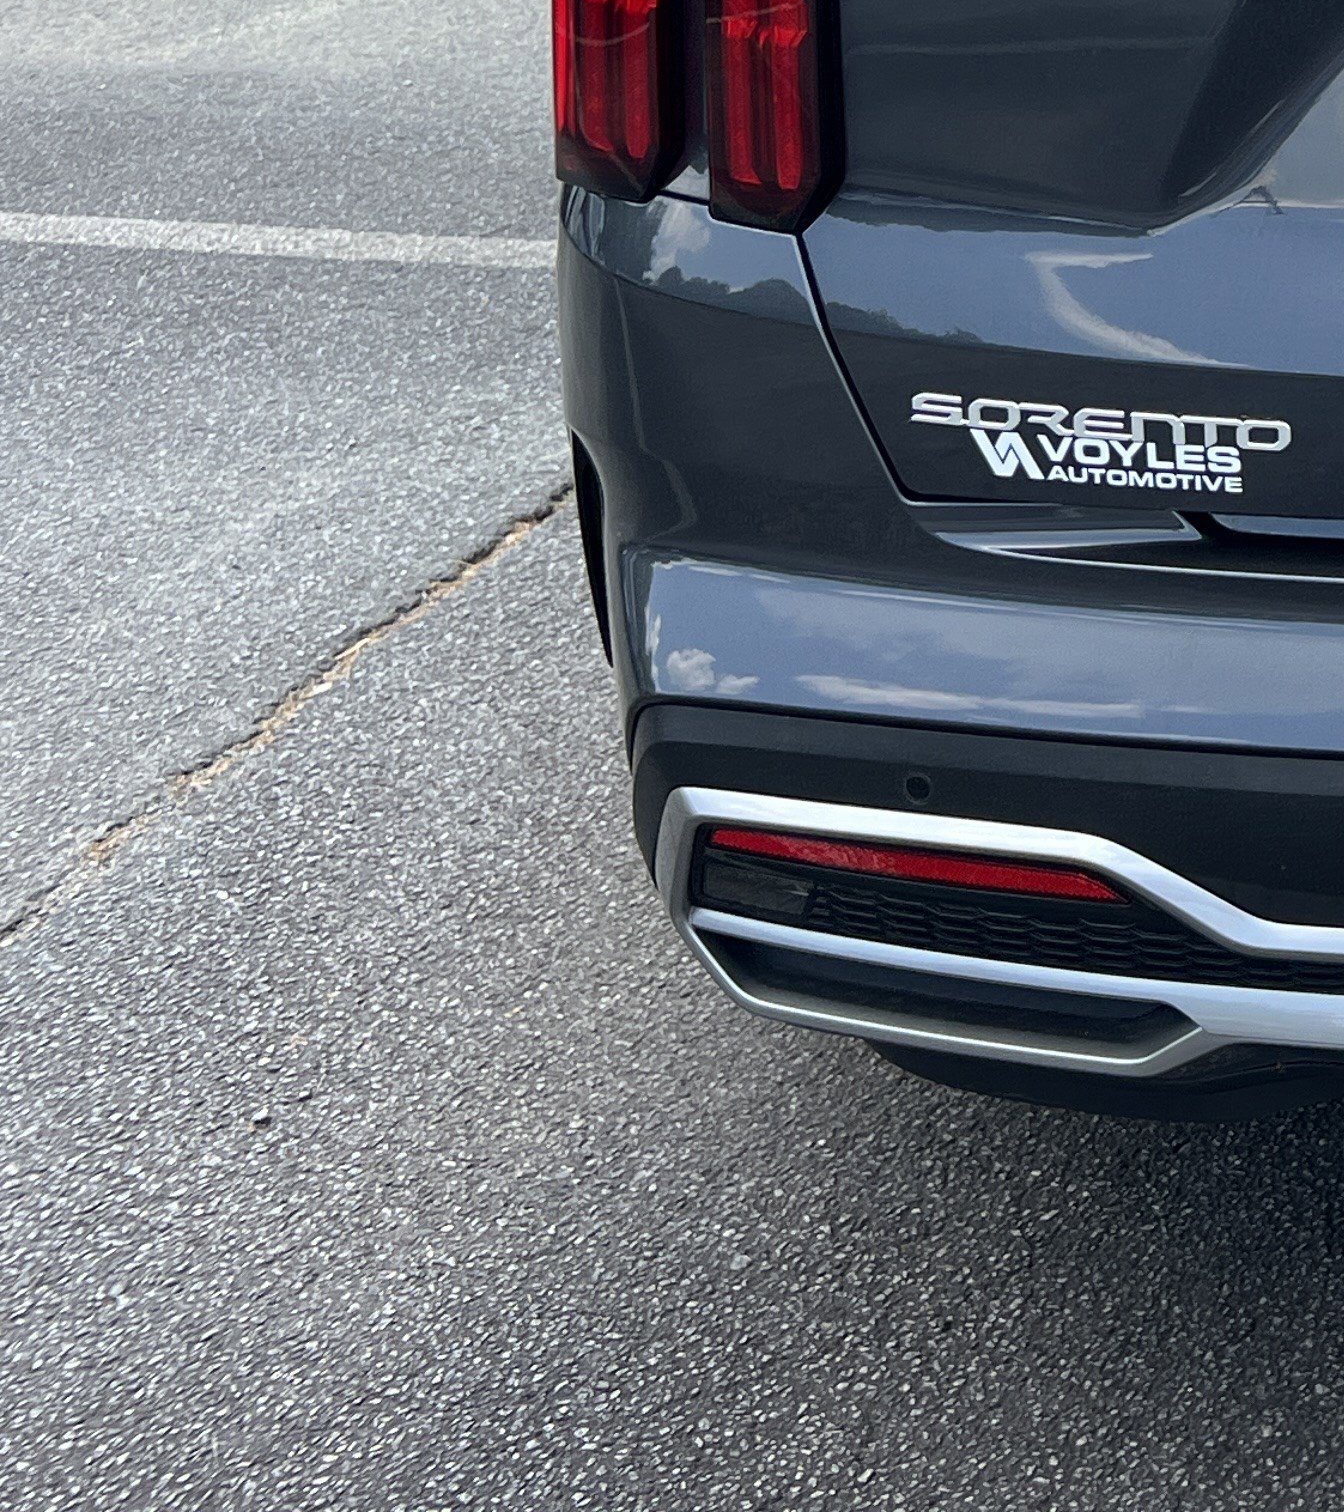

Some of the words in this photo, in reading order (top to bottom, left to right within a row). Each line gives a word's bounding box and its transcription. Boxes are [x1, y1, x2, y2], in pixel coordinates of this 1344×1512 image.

[910, 391, 1292, 451] SORENTO
[1036, 434, 1242, 473] VOYLES
[1045, 465, 1243, 493] AUTOMOTIVE
